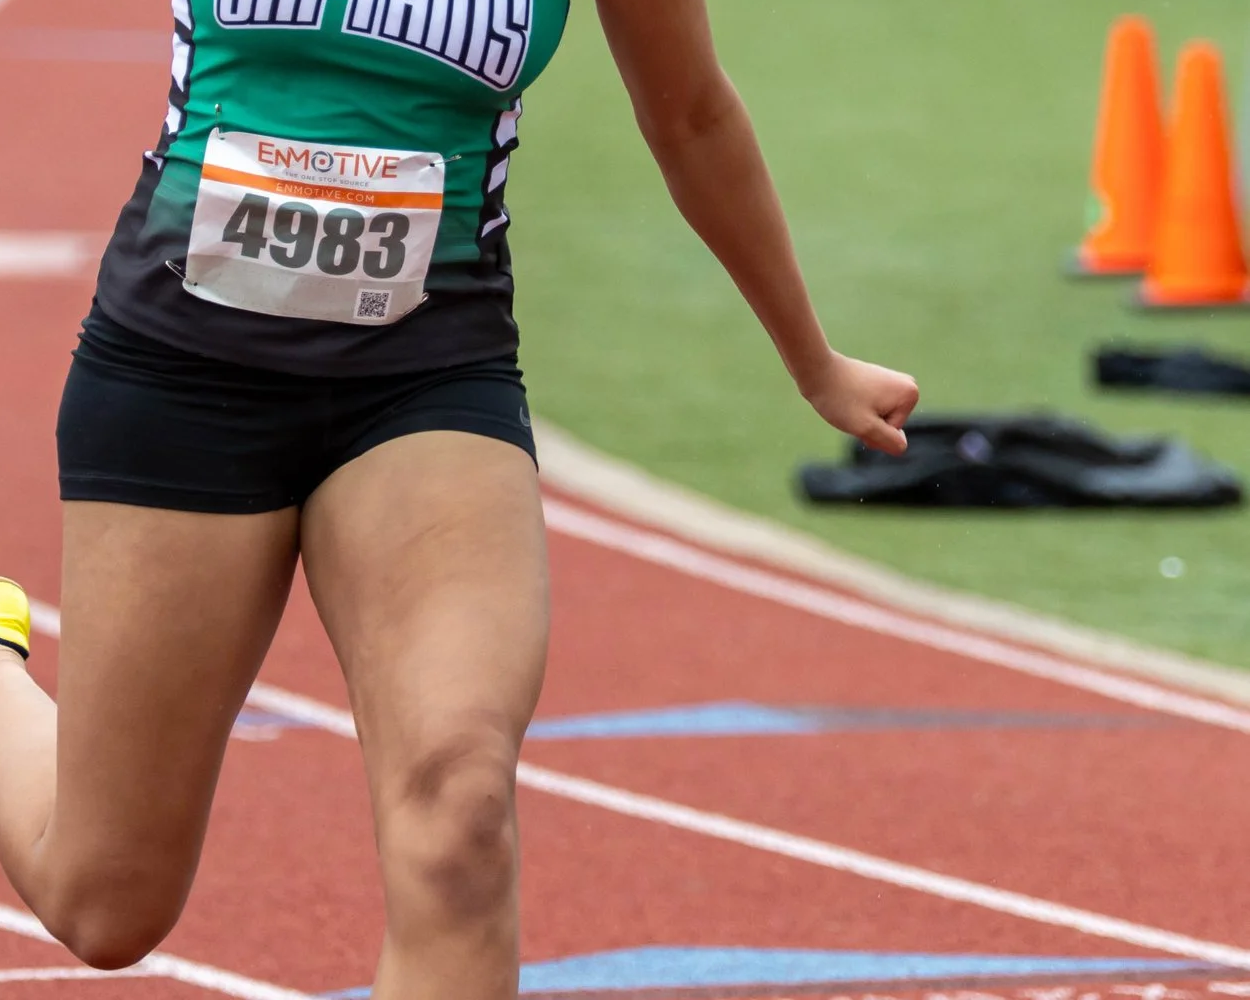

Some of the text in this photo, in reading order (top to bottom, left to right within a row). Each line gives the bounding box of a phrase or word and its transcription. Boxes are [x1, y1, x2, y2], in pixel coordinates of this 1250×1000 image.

[301, 174, 315, 182] ONE
[319, 176, 337, 184] STOP
[340, 179, 369, 188] SOURCE
[276, 182, 375, 204] ENMOTIVE.COM
[222, 192, 411, 279] 4983
